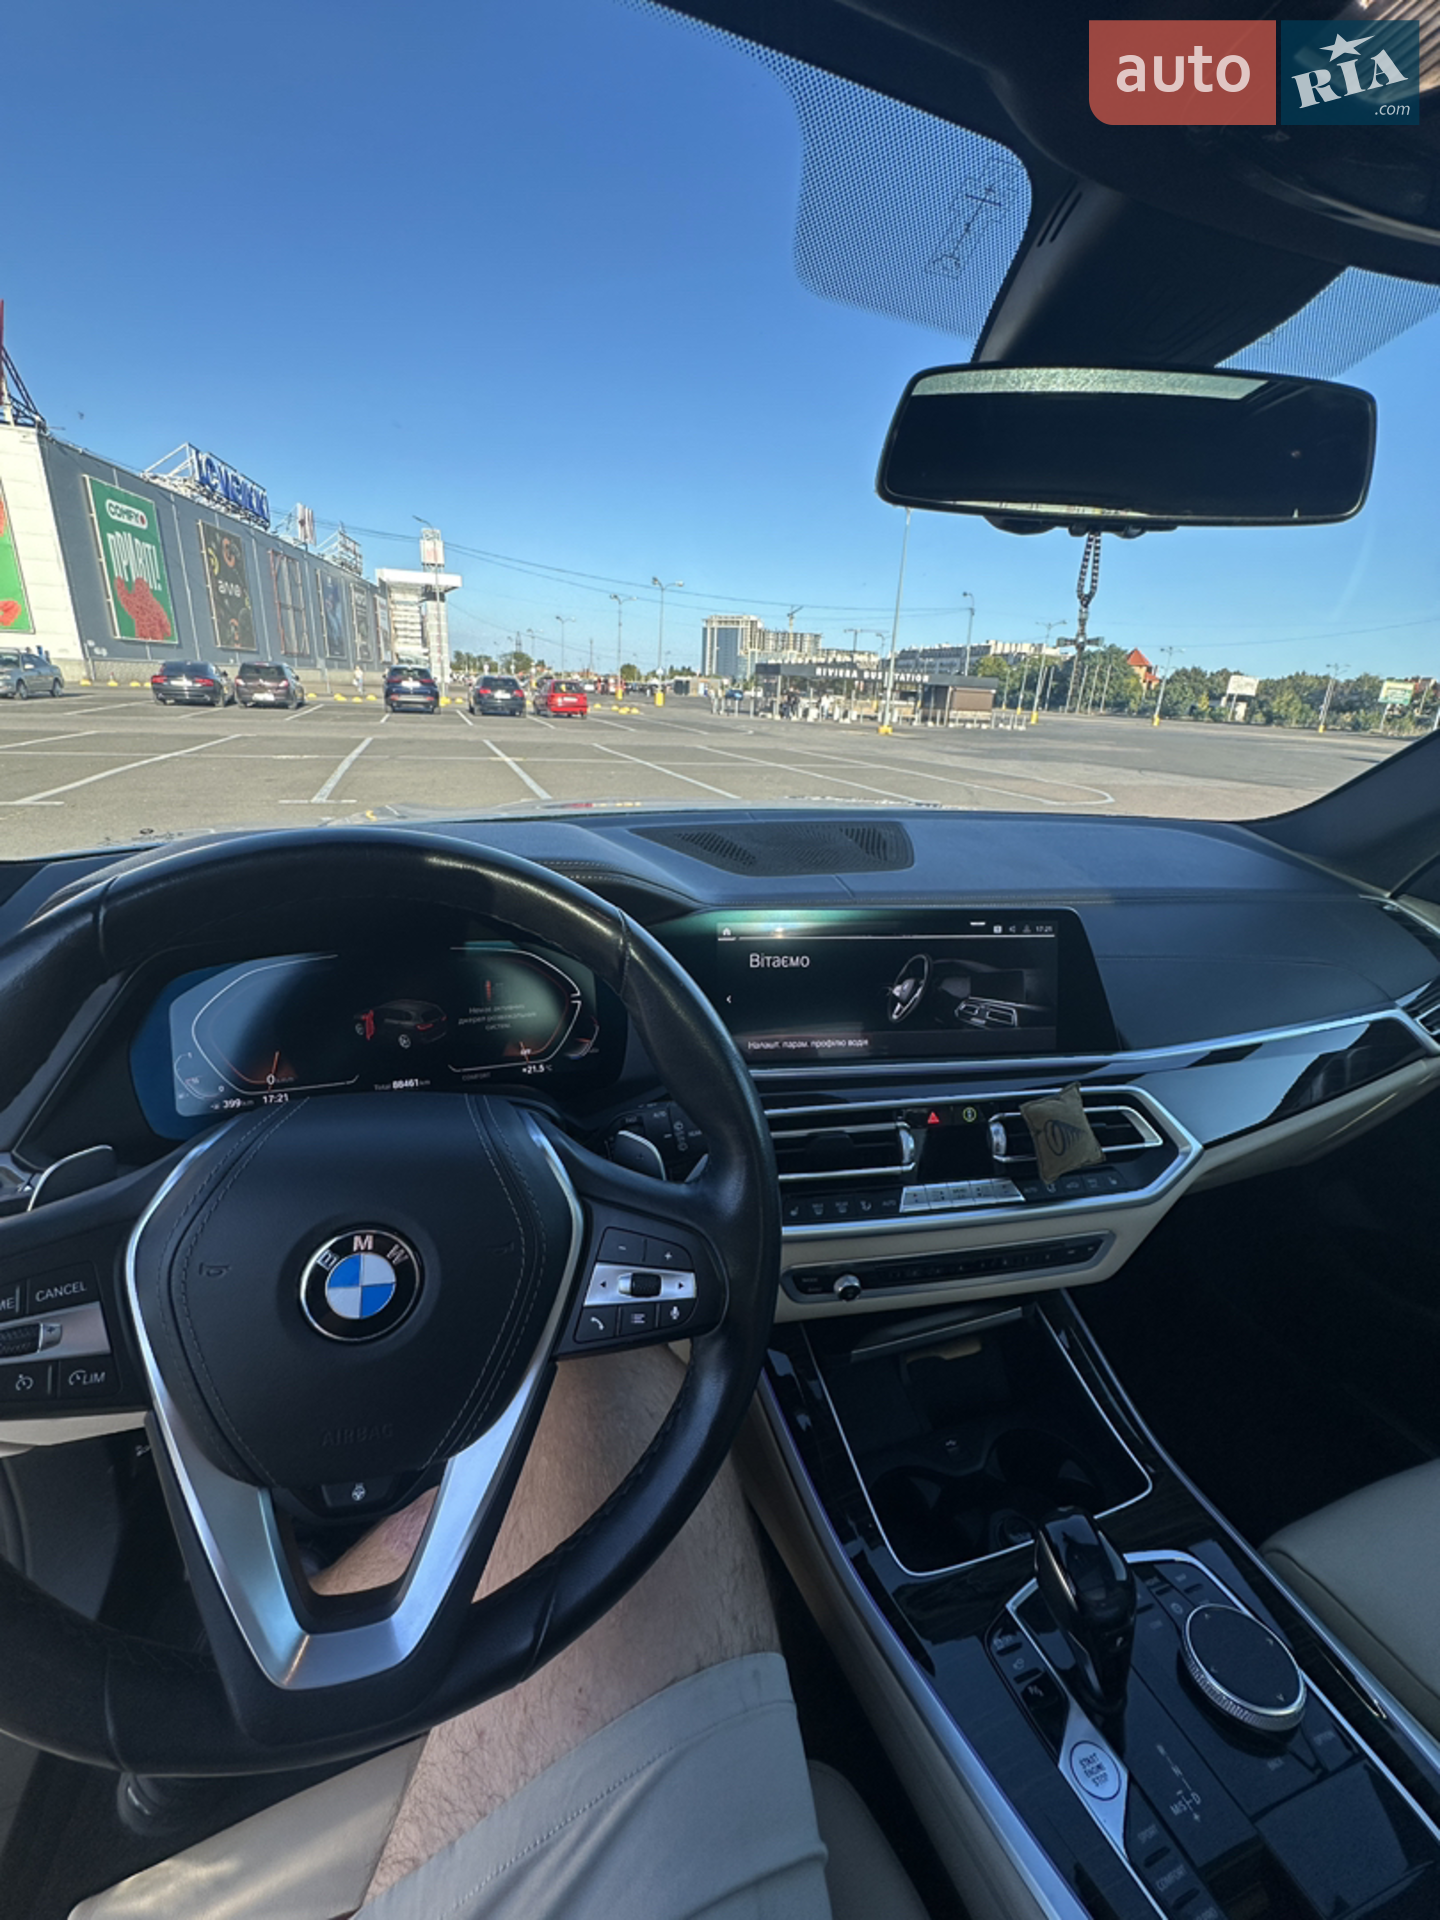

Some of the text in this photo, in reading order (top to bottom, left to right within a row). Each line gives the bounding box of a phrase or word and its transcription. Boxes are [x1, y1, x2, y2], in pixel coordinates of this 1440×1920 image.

[815, 667, 930, 683] RIVIERA BUS TATION
[749, 953, 811, 968] Вітаємо
[262, 1093, 290, 1104] 17:21
[316, 1234, 409, 1272] BMW
[35, 1281, 87, 1302] CANCEL
